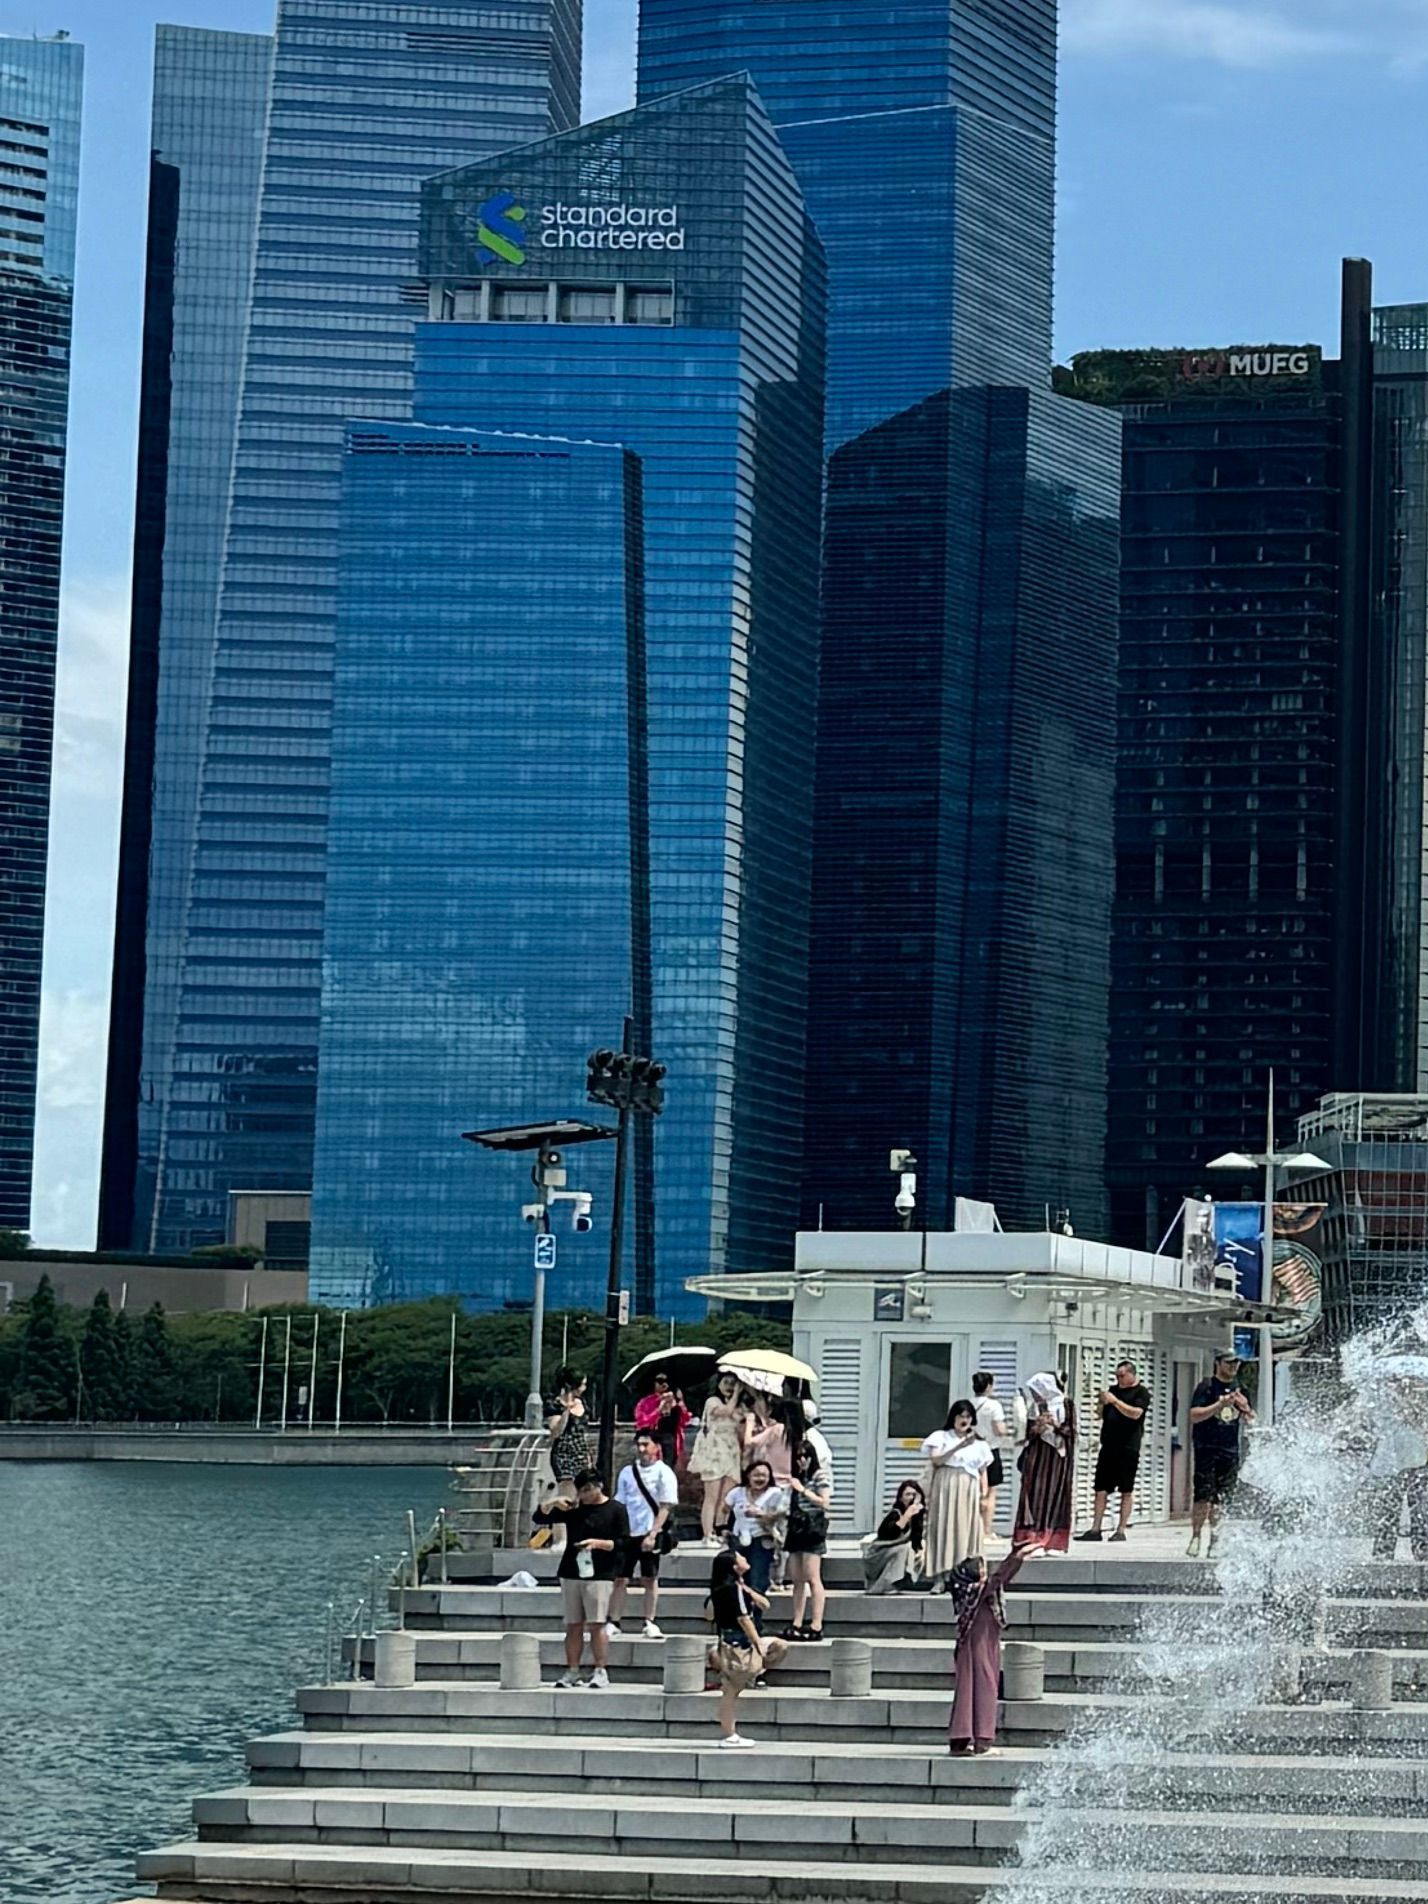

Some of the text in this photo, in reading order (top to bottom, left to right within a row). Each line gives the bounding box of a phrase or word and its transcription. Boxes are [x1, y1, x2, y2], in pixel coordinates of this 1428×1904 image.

[540, 201, 677, 227] standard
[540, 225, 685, 250] chartered
[1229, 352, 1309, 376] MUFG
